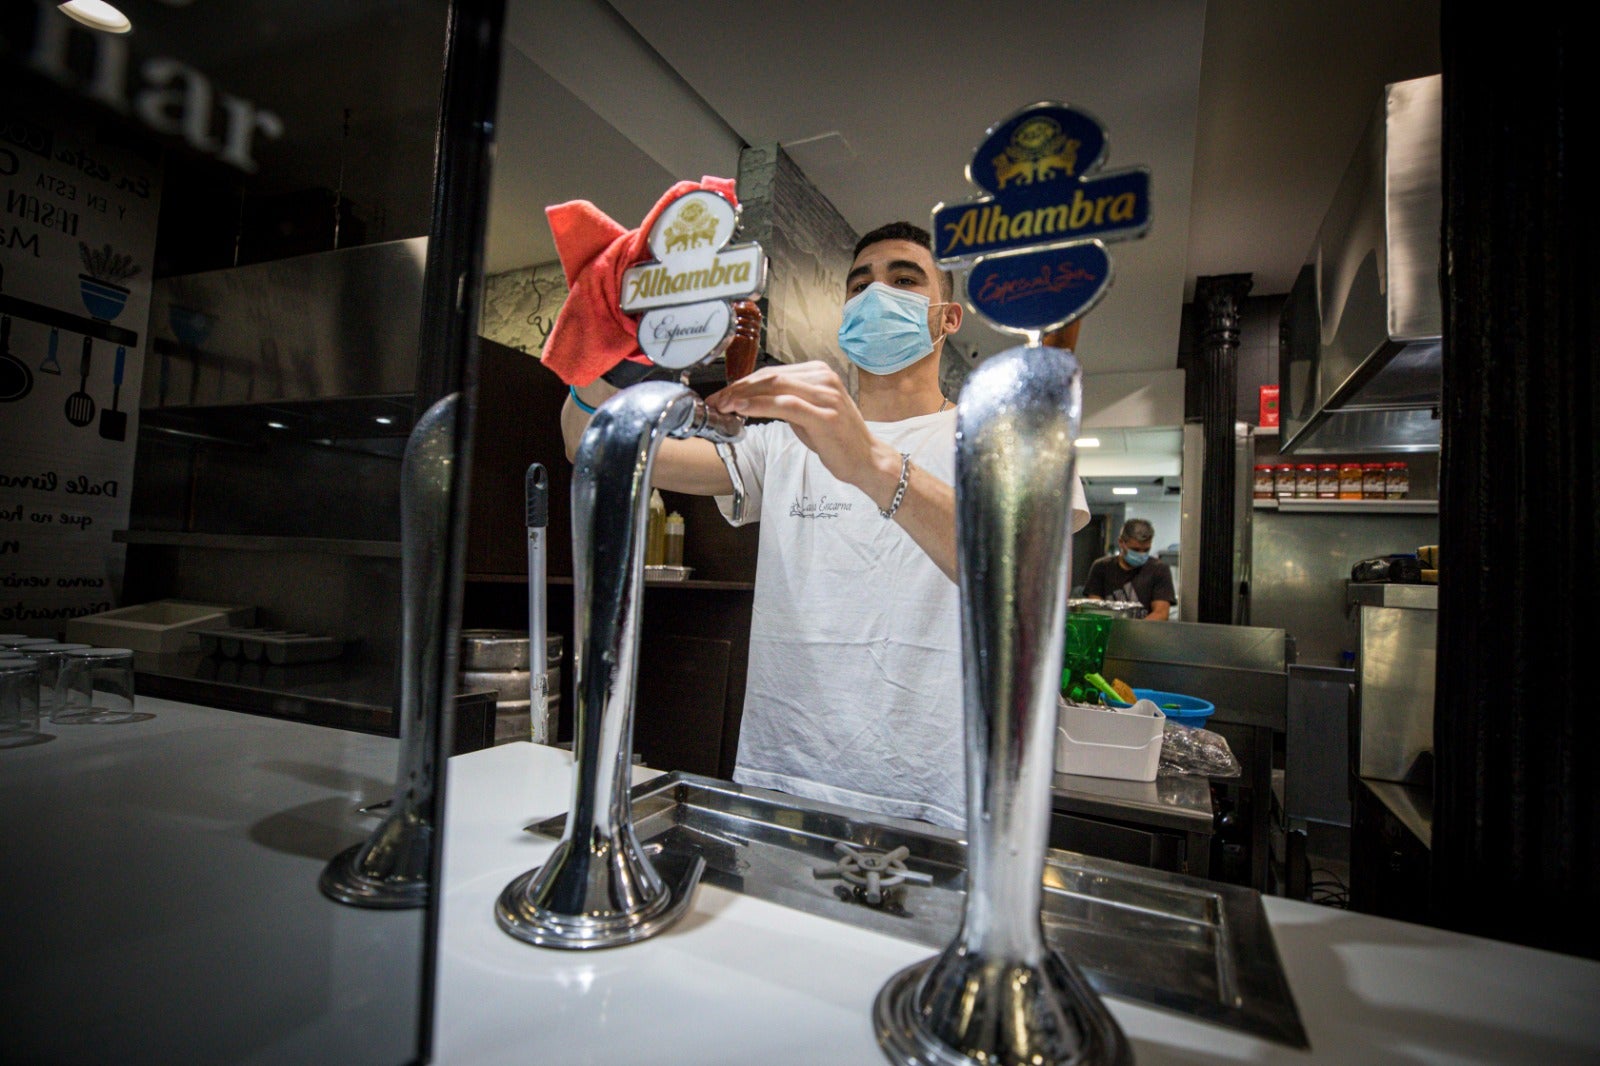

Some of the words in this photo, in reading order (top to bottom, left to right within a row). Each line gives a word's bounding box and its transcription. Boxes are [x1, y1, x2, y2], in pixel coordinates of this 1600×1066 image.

[941, 188, 1137, 255] Alhambra
[626, 256, 752, 305] Alhambra
[649, 309, 720, 357] Especial
[818, 495, 853, 511] Encarna
